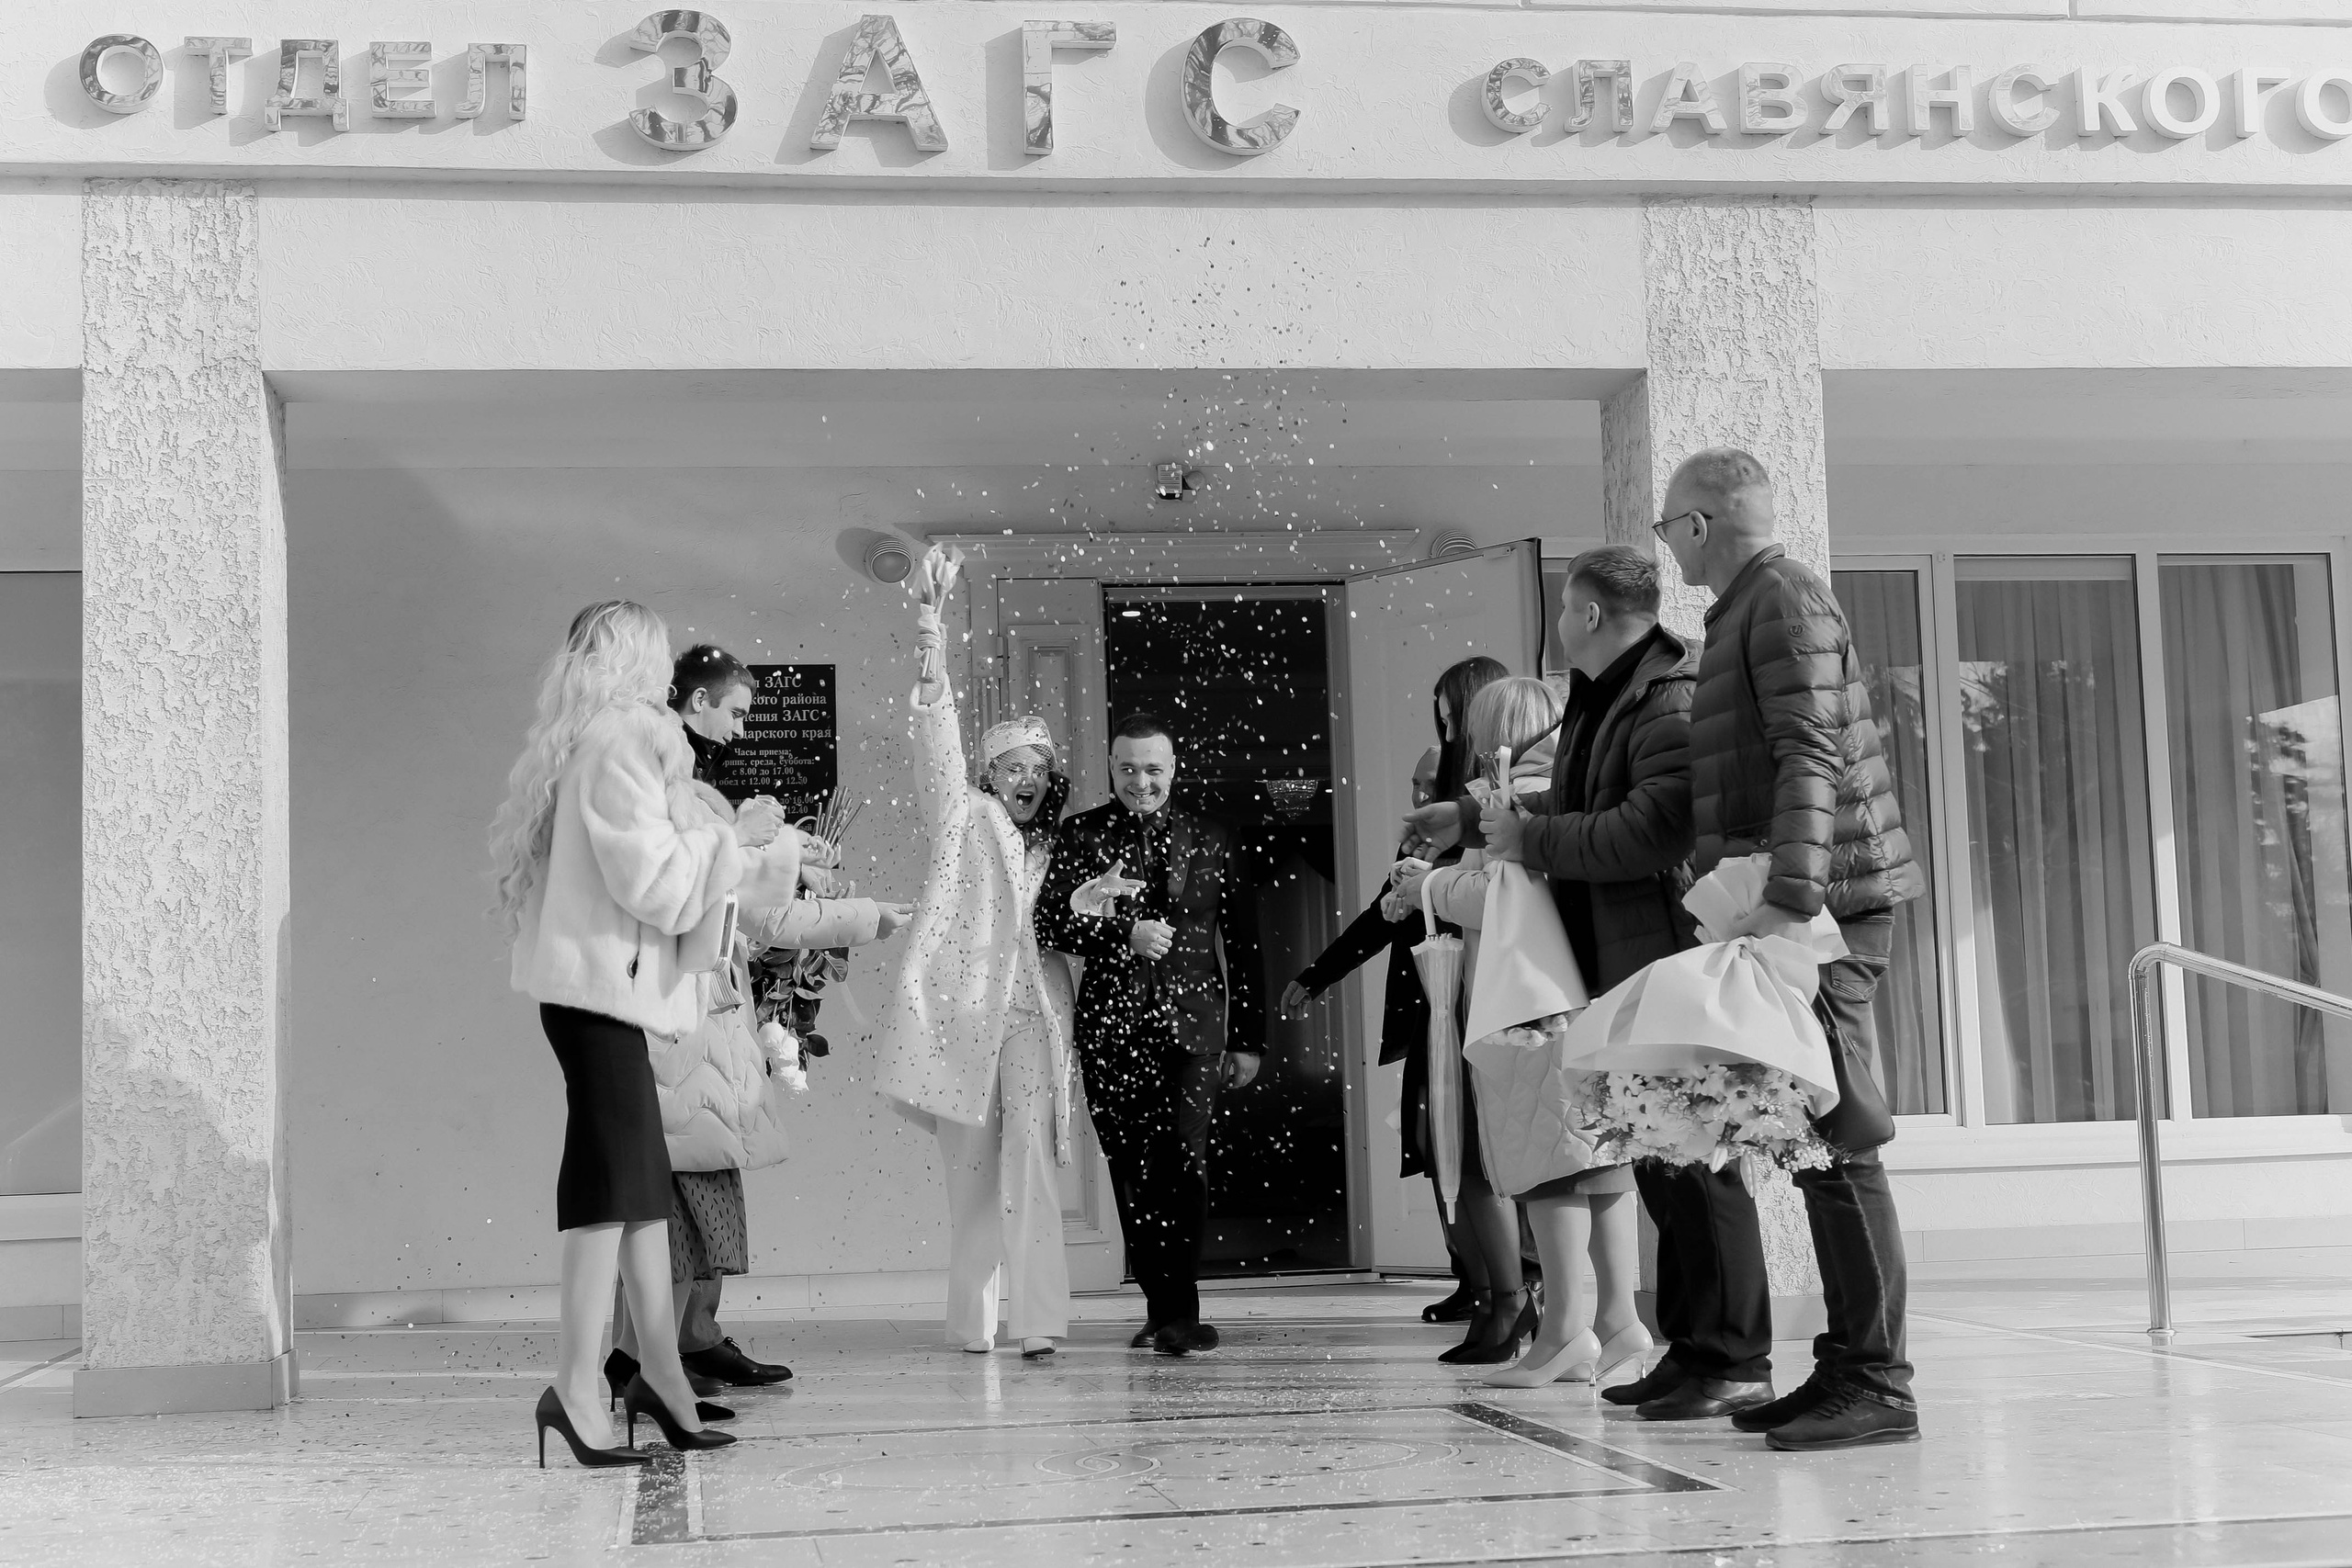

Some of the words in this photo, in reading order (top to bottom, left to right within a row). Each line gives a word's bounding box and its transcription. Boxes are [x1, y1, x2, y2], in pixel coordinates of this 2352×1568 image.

[79, 34, 526, 132] ОТДЕЛ
[628, 9, 1302, 156] ЗАГС
[1480, 57, 2352, 141] СЛАВЯНСКОГО
[764, 675, 802, 688] ЗАГС
[782, 693, 827, 708] района
[783, 709, 820, 722] ЗАГС
[801, 728, 832, 740] края
[734, 748, 756, 756] Часы
[740, 767, 757, 775] 8.00
[773, 766, 795, 775] 17.00
[749, 776, 771, 785] 12.00
